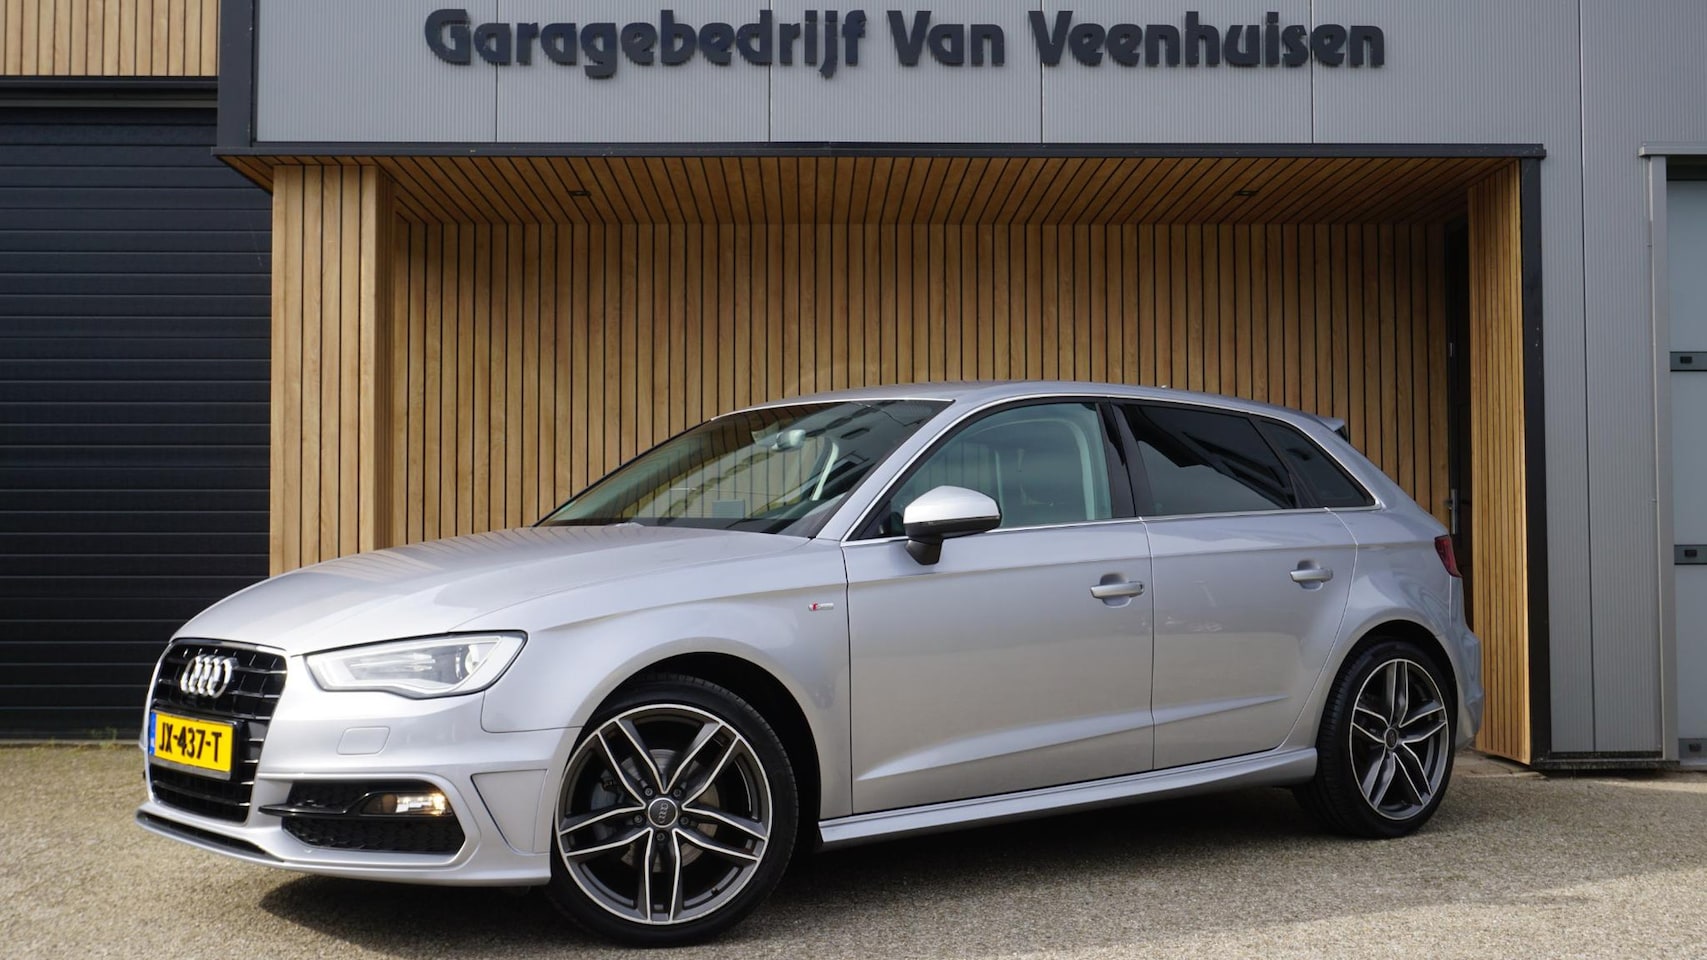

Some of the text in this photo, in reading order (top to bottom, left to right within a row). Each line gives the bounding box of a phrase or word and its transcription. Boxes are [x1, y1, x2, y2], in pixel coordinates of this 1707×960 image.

[424, 8, 1385, 79] Garagebedrijf Van Veenhuisen
[159, 722, 222, 762] JX-437-T
